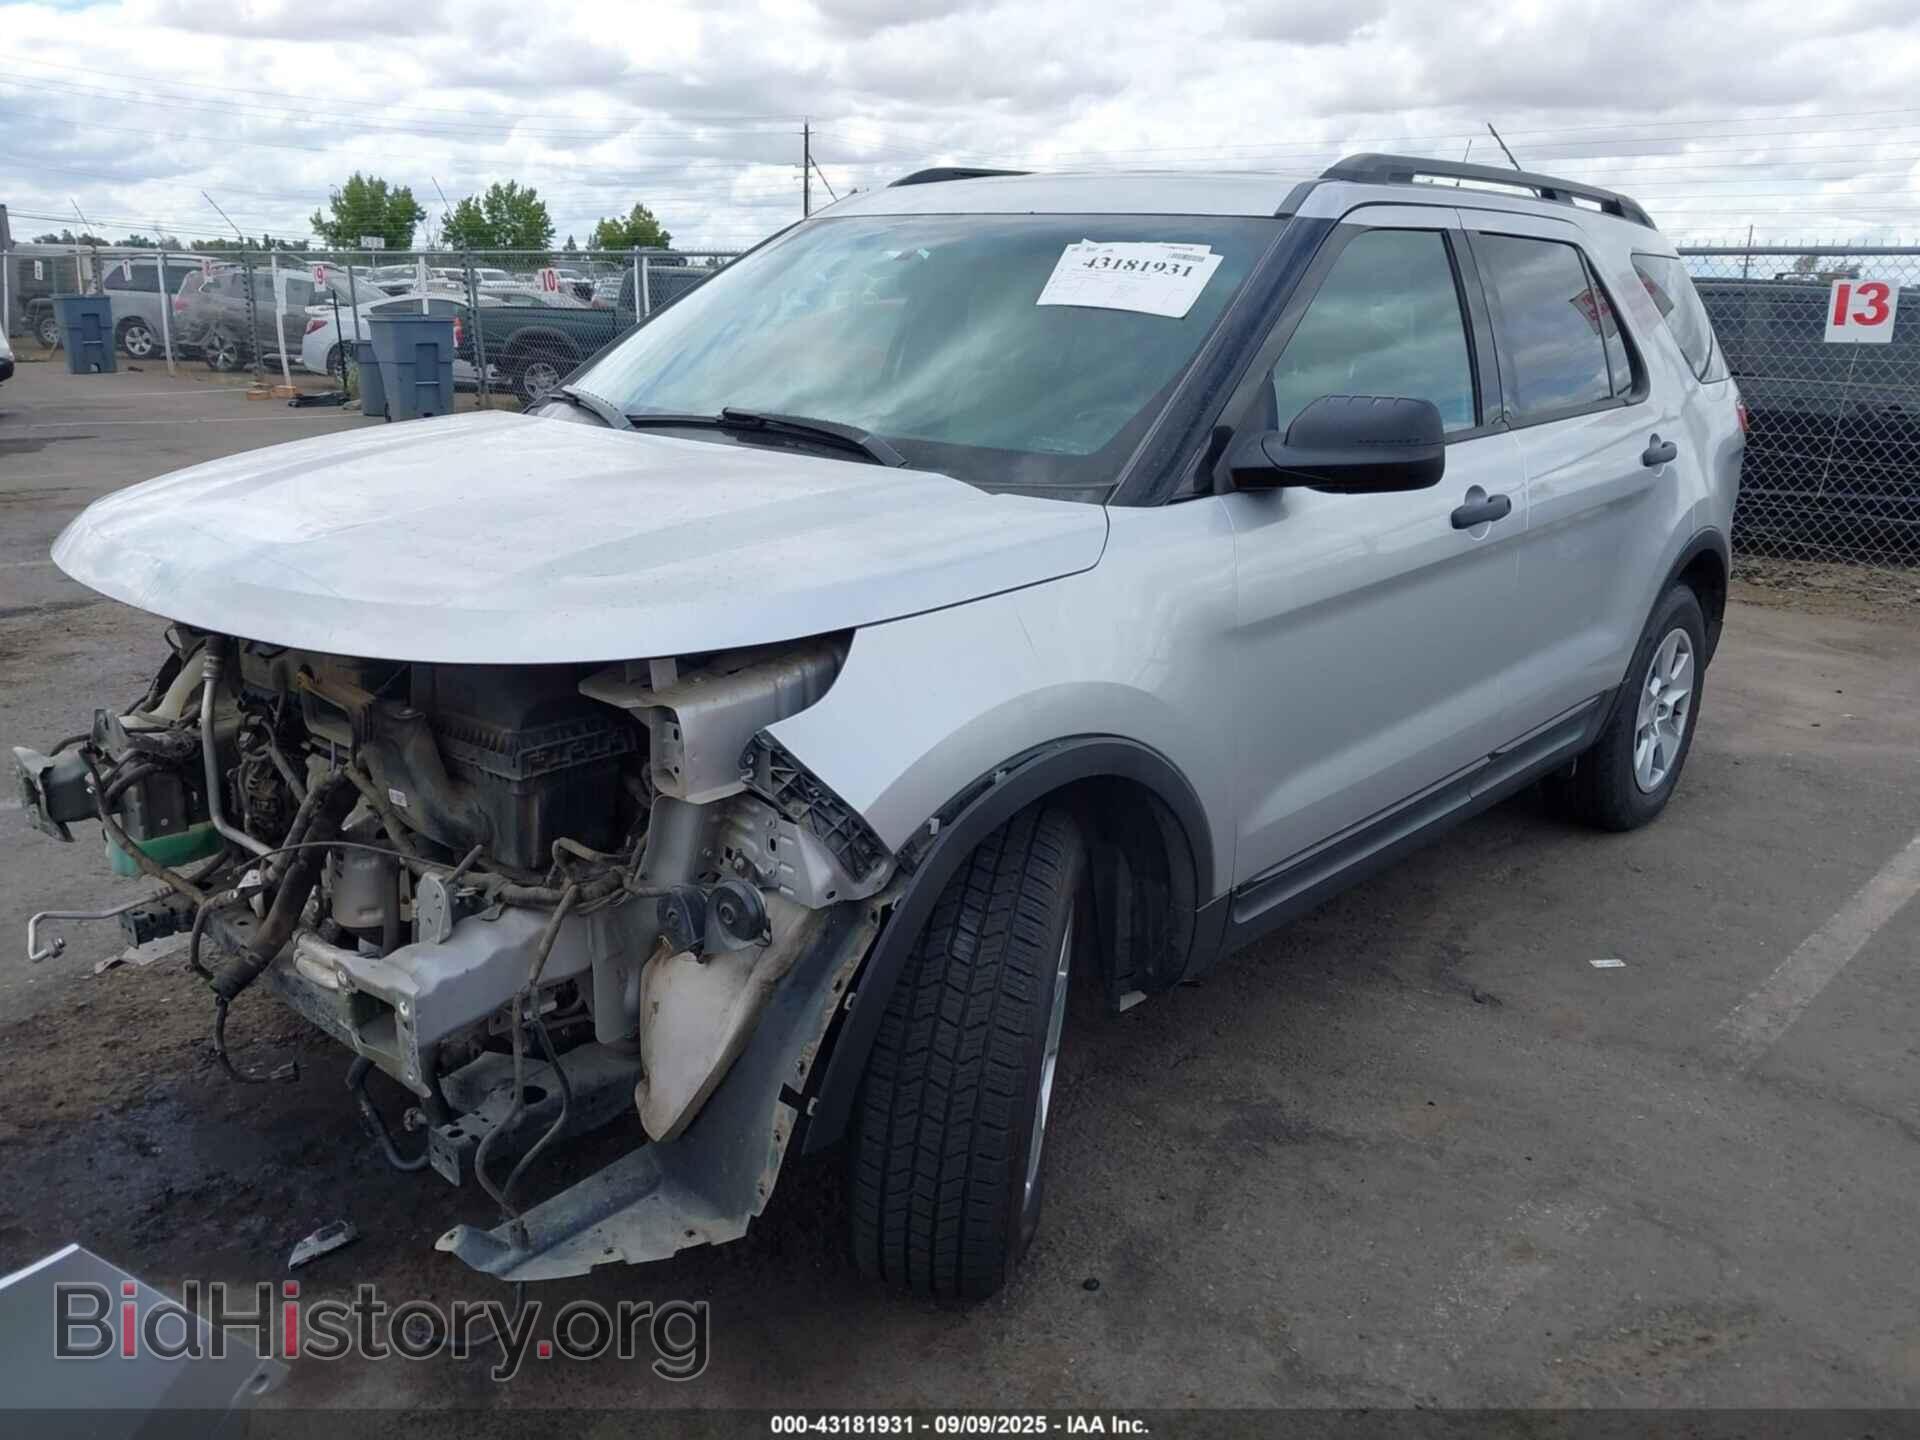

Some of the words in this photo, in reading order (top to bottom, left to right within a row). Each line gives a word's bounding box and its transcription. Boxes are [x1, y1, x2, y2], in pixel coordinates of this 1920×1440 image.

[1082, 256, 1193, 278] 43181931
[543, 269, 556, 291] 10
[1833, 282, 1890, 326] 13
